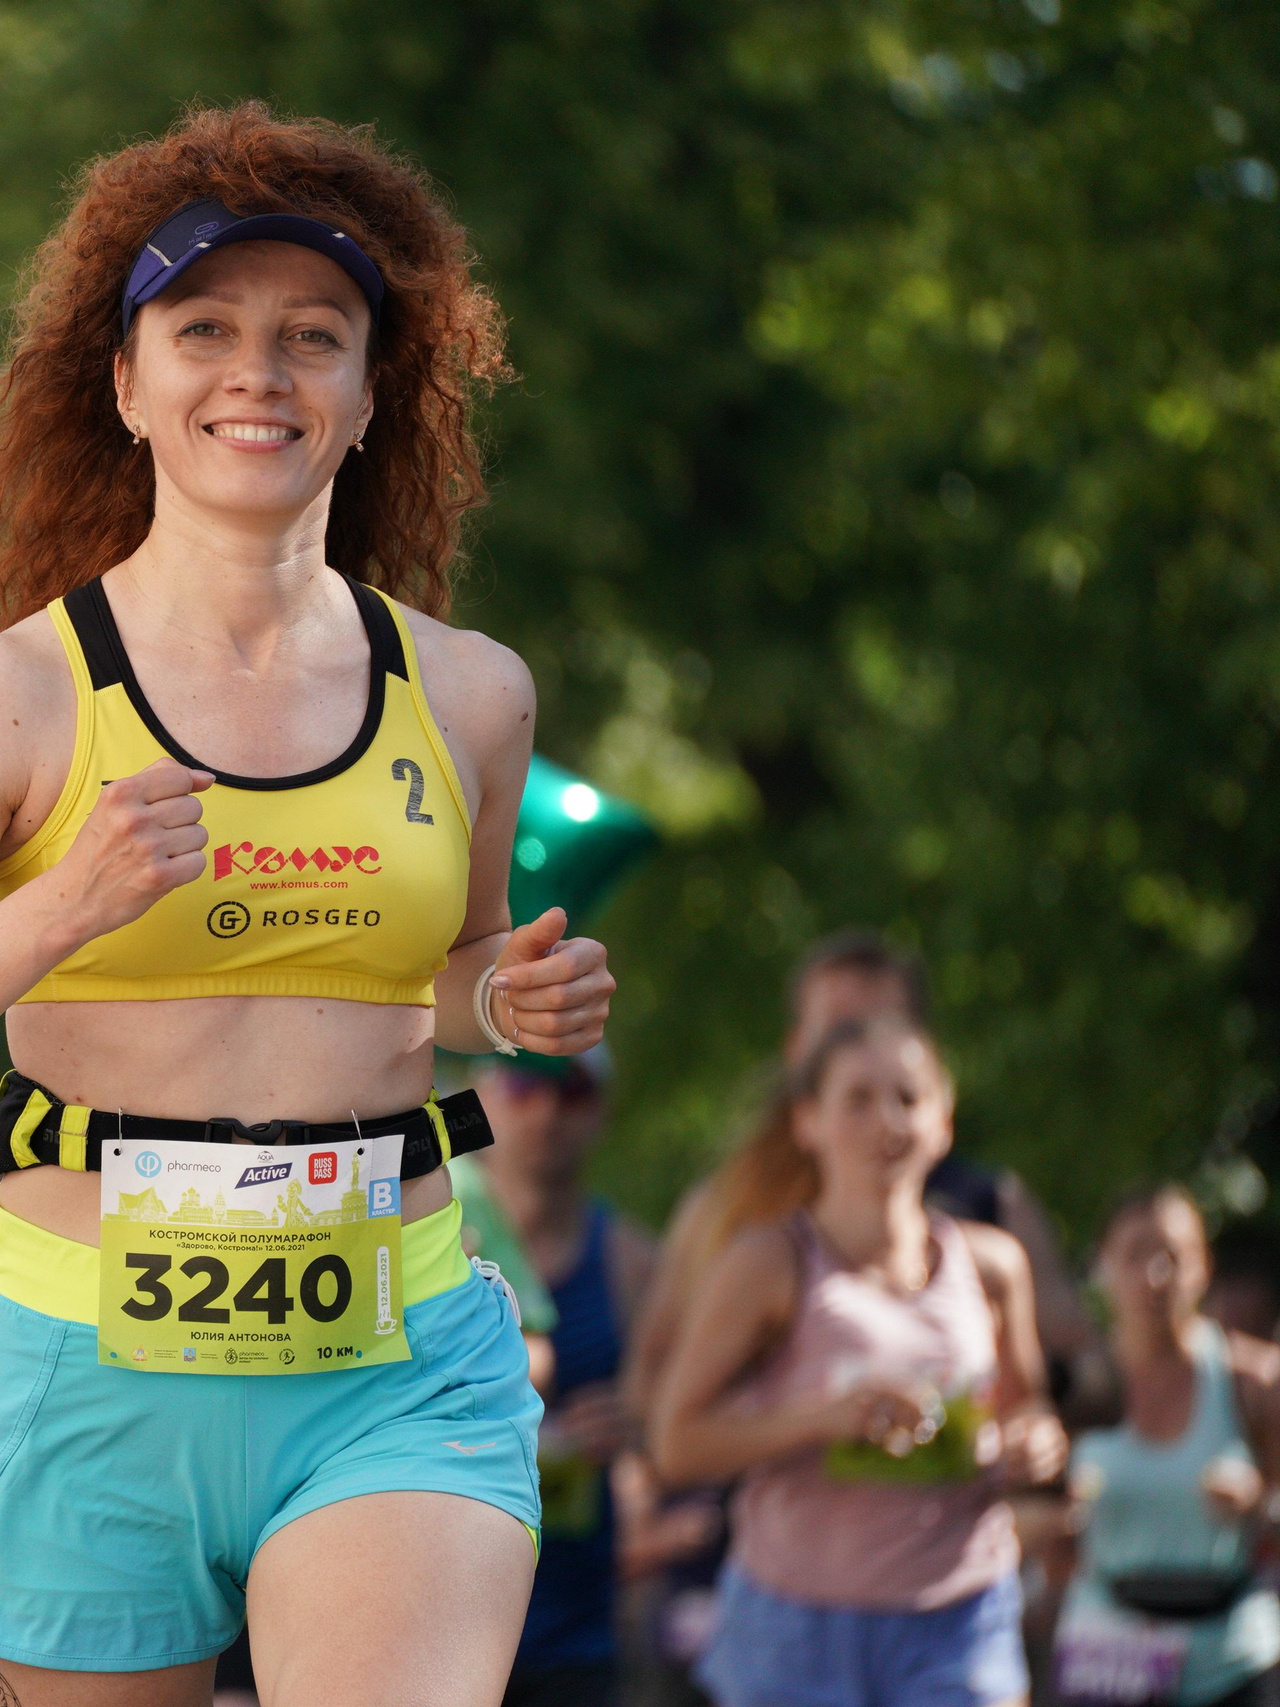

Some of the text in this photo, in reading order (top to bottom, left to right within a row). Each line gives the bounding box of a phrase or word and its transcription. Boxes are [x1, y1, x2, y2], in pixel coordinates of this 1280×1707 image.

[391, 758, 434, 825] 2
[250, 880, 349, 890] www.komus.com
[262, 909, 381, 927] ROSGEO
[167, 1160, 222, 1173] pharmeco
[313, 1157, 333, 1169] RUSS
[313, 1168, 333, 1180] PASS
[371, 1208, 396, 1216] КЛАСТЕР
[149, 1229, 331, 1243] КОСТРОМСКОЙ ПОЛУМАРАФОН
[120, 1252, 353, 1325] 3240
[190, 1331, 292, 1342] ЮЛИЯ АНТОНОВА
[317, 1346, 333, 1359] 10
